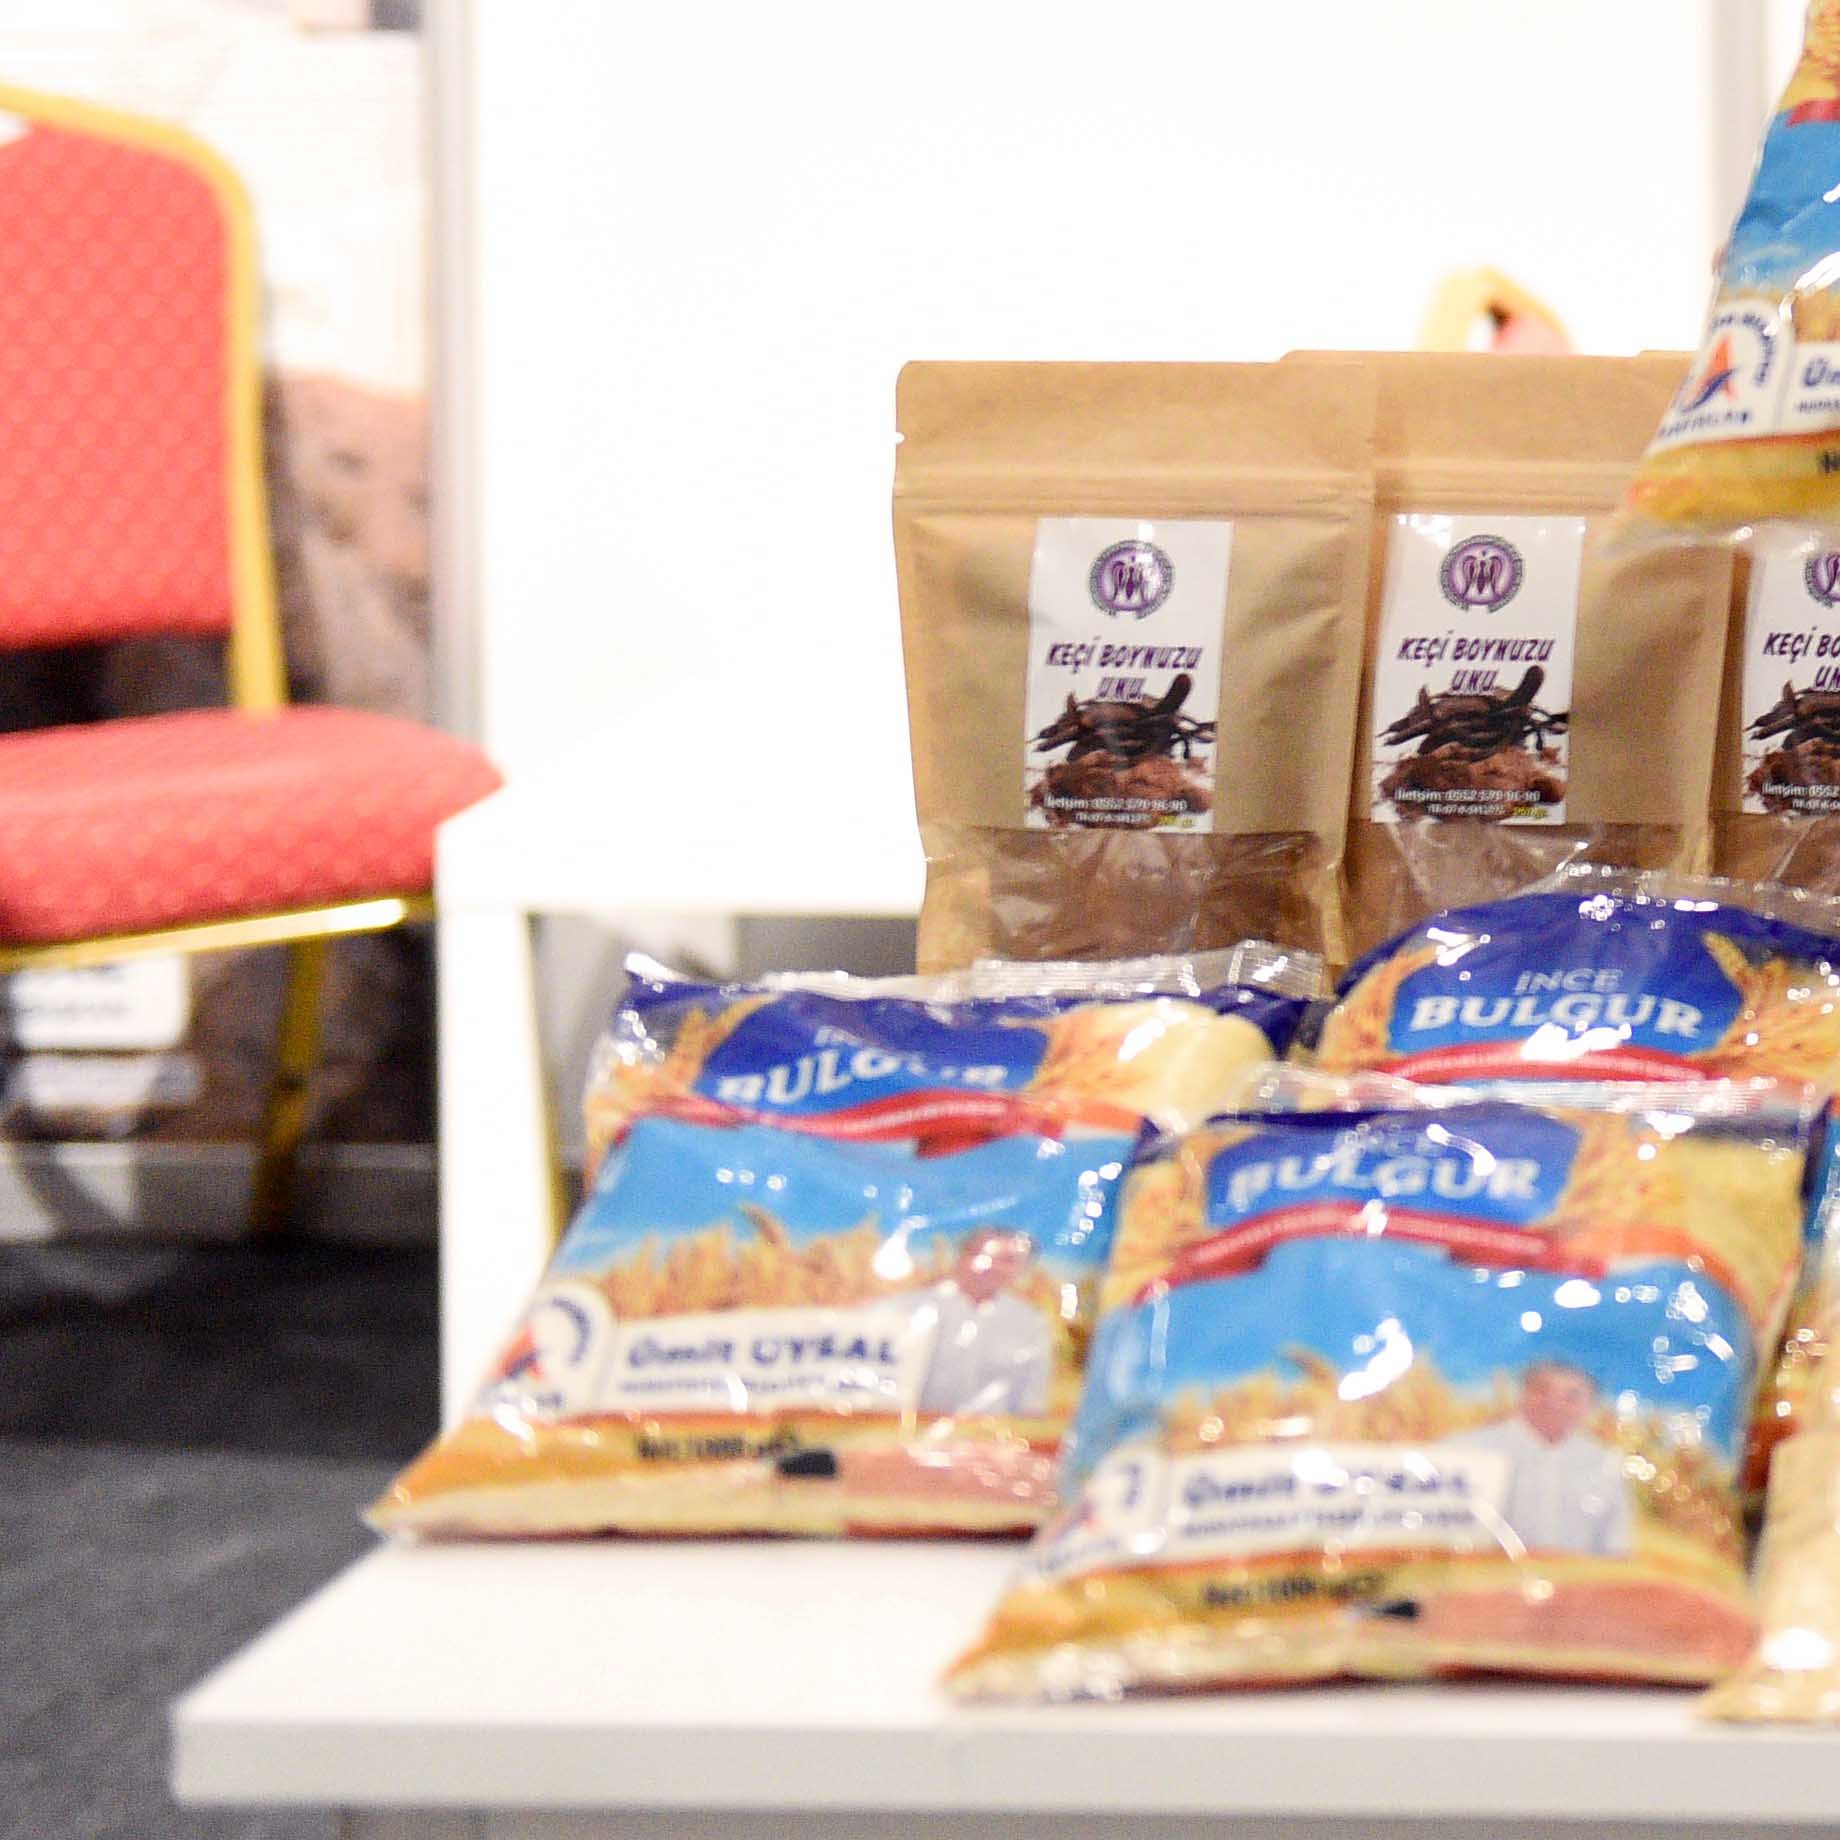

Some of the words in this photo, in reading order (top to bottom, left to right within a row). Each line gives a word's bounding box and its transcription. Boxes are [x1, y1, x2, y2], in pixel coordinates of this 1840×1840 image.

[1046, 636, 1102, 674] KEÇİ
[1099, 646, 1203, 670] BOYNUZU
[1399, 629, 1454, 668] KEÇİ
[1452, 638, 1556, 662] BOYNUZU
[1763, 626, 1817, 663] KEÇİ
[1098, 677, 1146, 701] UNU
[1451, 670, 1498, 693] UNU
[1409, 992, 1704, 1037] BULGUR
[716, 1046, 1009, 1107] BULGR
[1226, 1152, 1545, 1212] BULGUR
[750, 1334, 896, 1365] UYSAL
